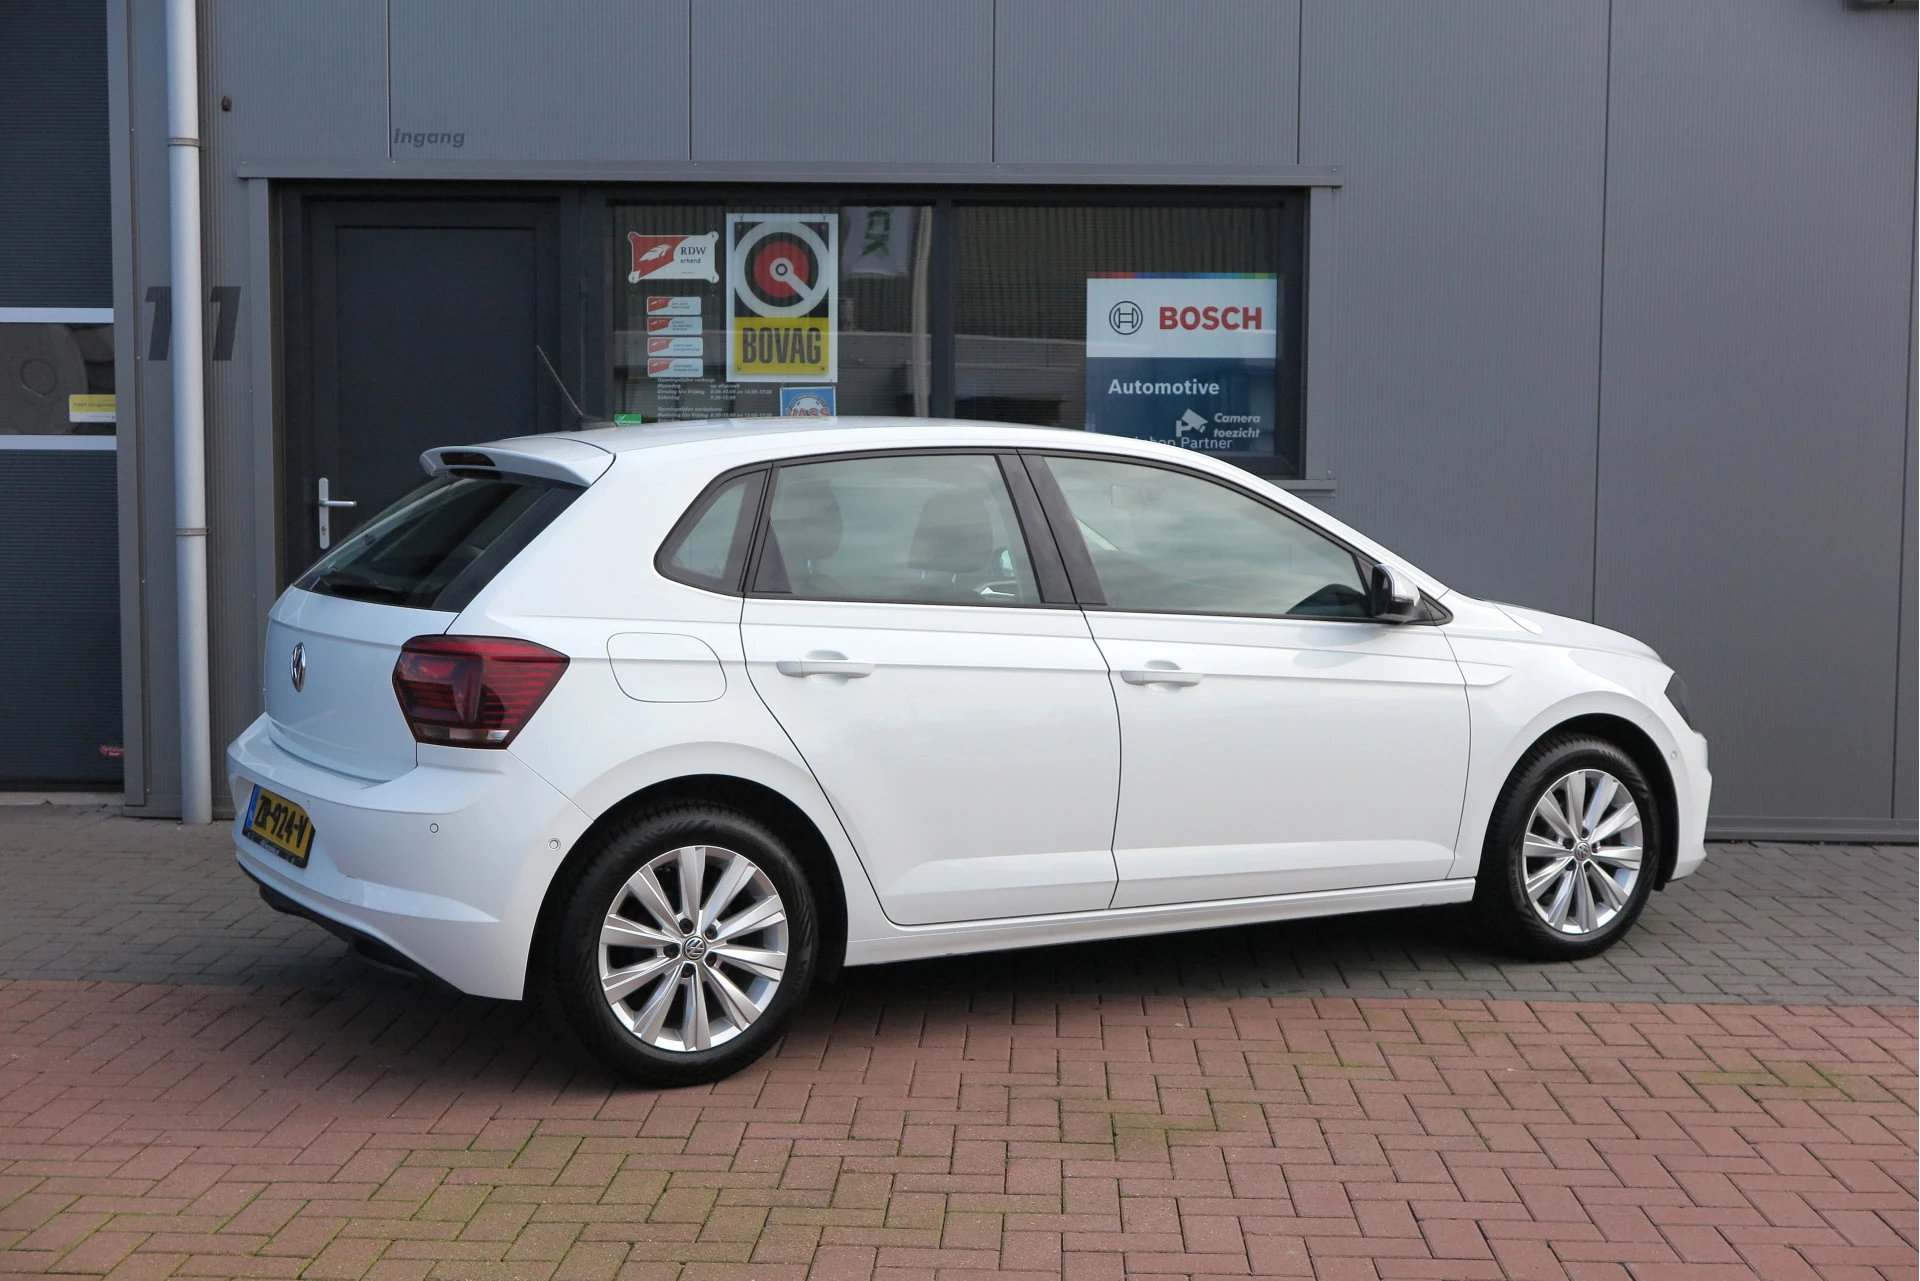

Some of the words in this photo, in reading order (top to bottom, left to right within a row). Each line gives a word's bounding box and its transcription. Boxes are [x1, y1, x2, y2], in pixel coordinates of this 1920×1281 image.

[393, 127, 465, 148] Ingang
[680, 246, 707, 255] RDW
[144, 286, 241, 361] 11
[1159, 306, 1262, 331] BOSCH
[742, 326, 822, 364] BOVAG
[1108, 378, 1220, 395] Automotive
[1214, 412, 1261, 424] Camera
[1214, 427, 1261, 438] toezicht
[1181, 436, 1233, 449] Partner
